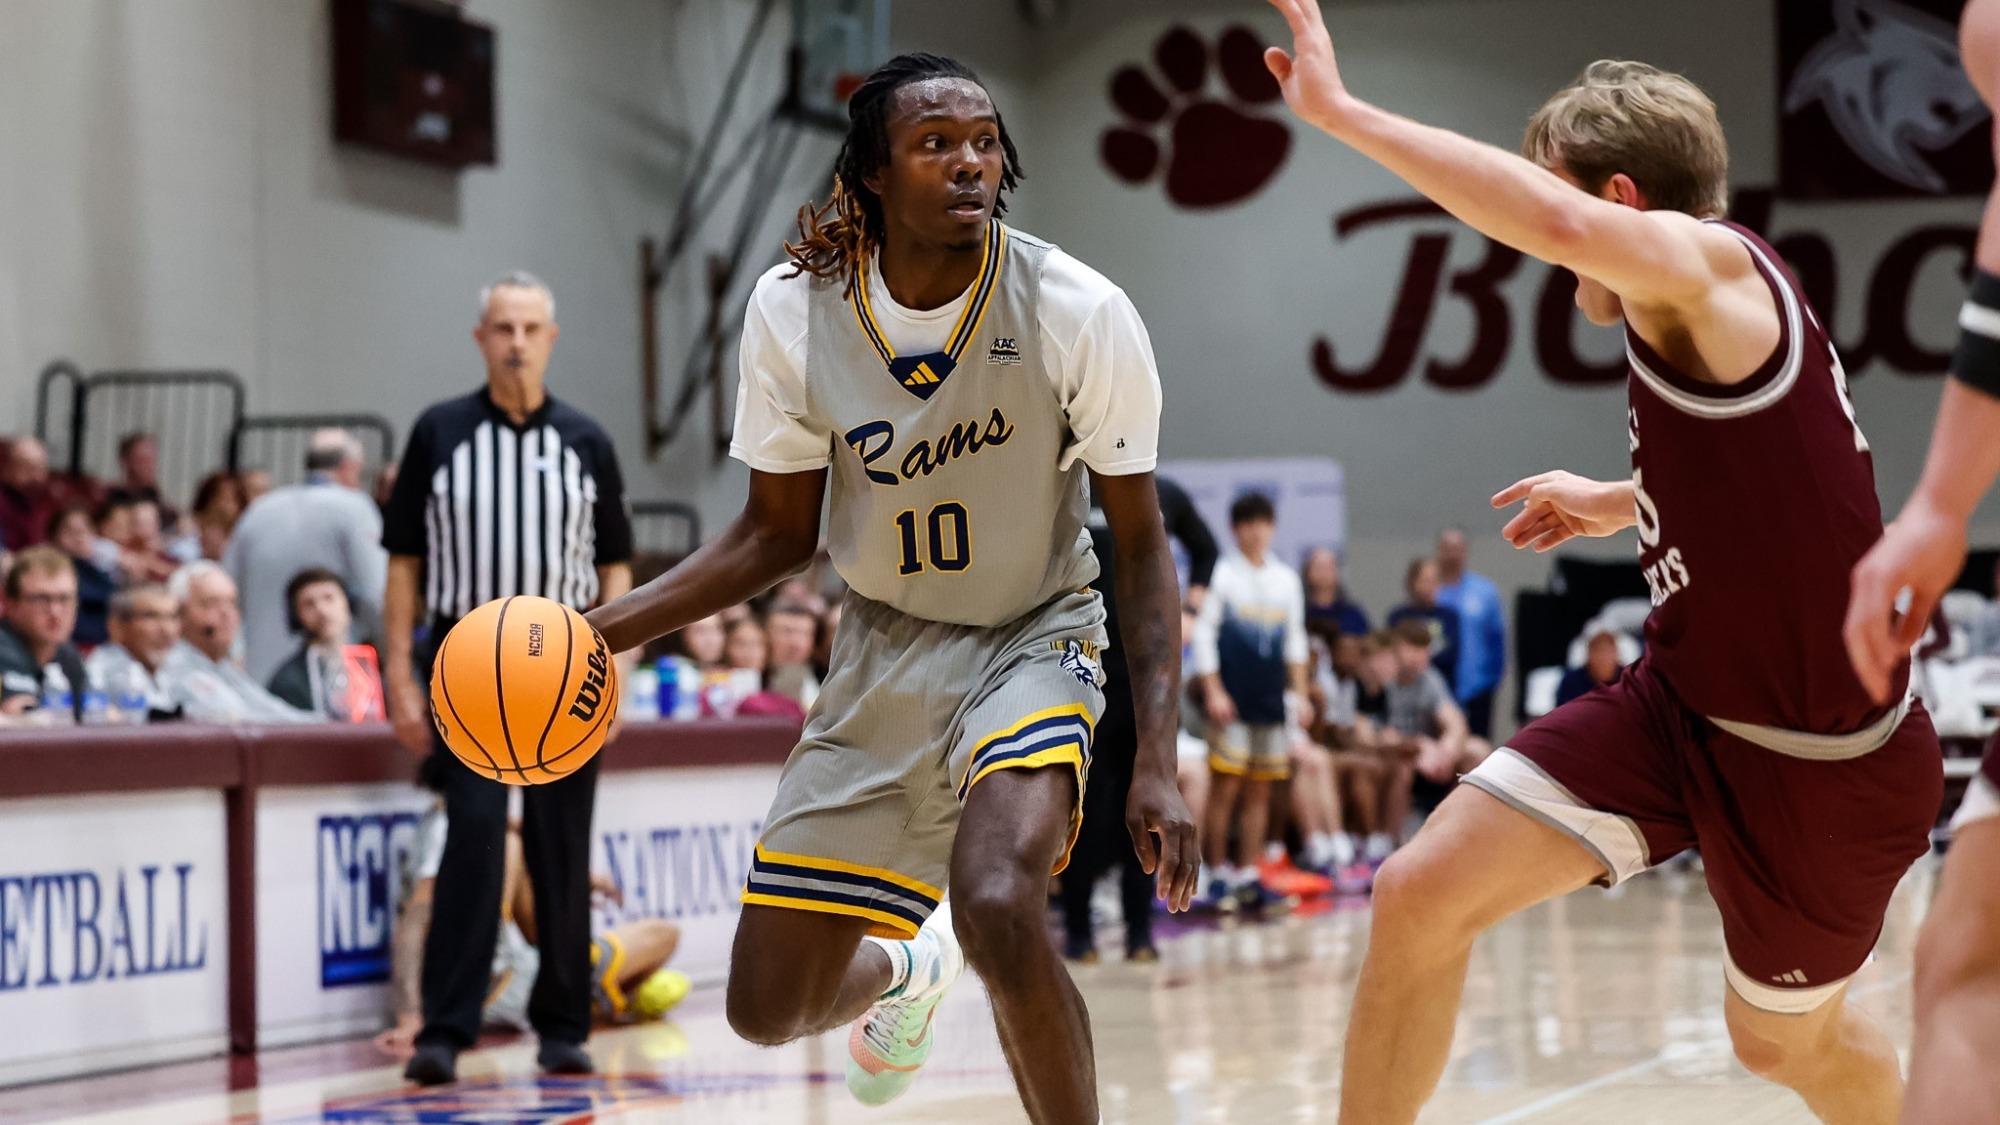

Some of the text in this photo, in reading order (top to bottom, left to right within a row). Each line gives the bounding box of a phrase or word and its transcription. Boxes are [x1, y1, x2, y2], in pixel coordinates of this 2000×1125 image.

[994, 337, 1016, 349] AAC
[844, 406, 1016, 486] Rams
[894, 499, 974, 577] 10
[528, 623, 541, 657] NCCAA
[602, 821, 762, 928] NATIONA
